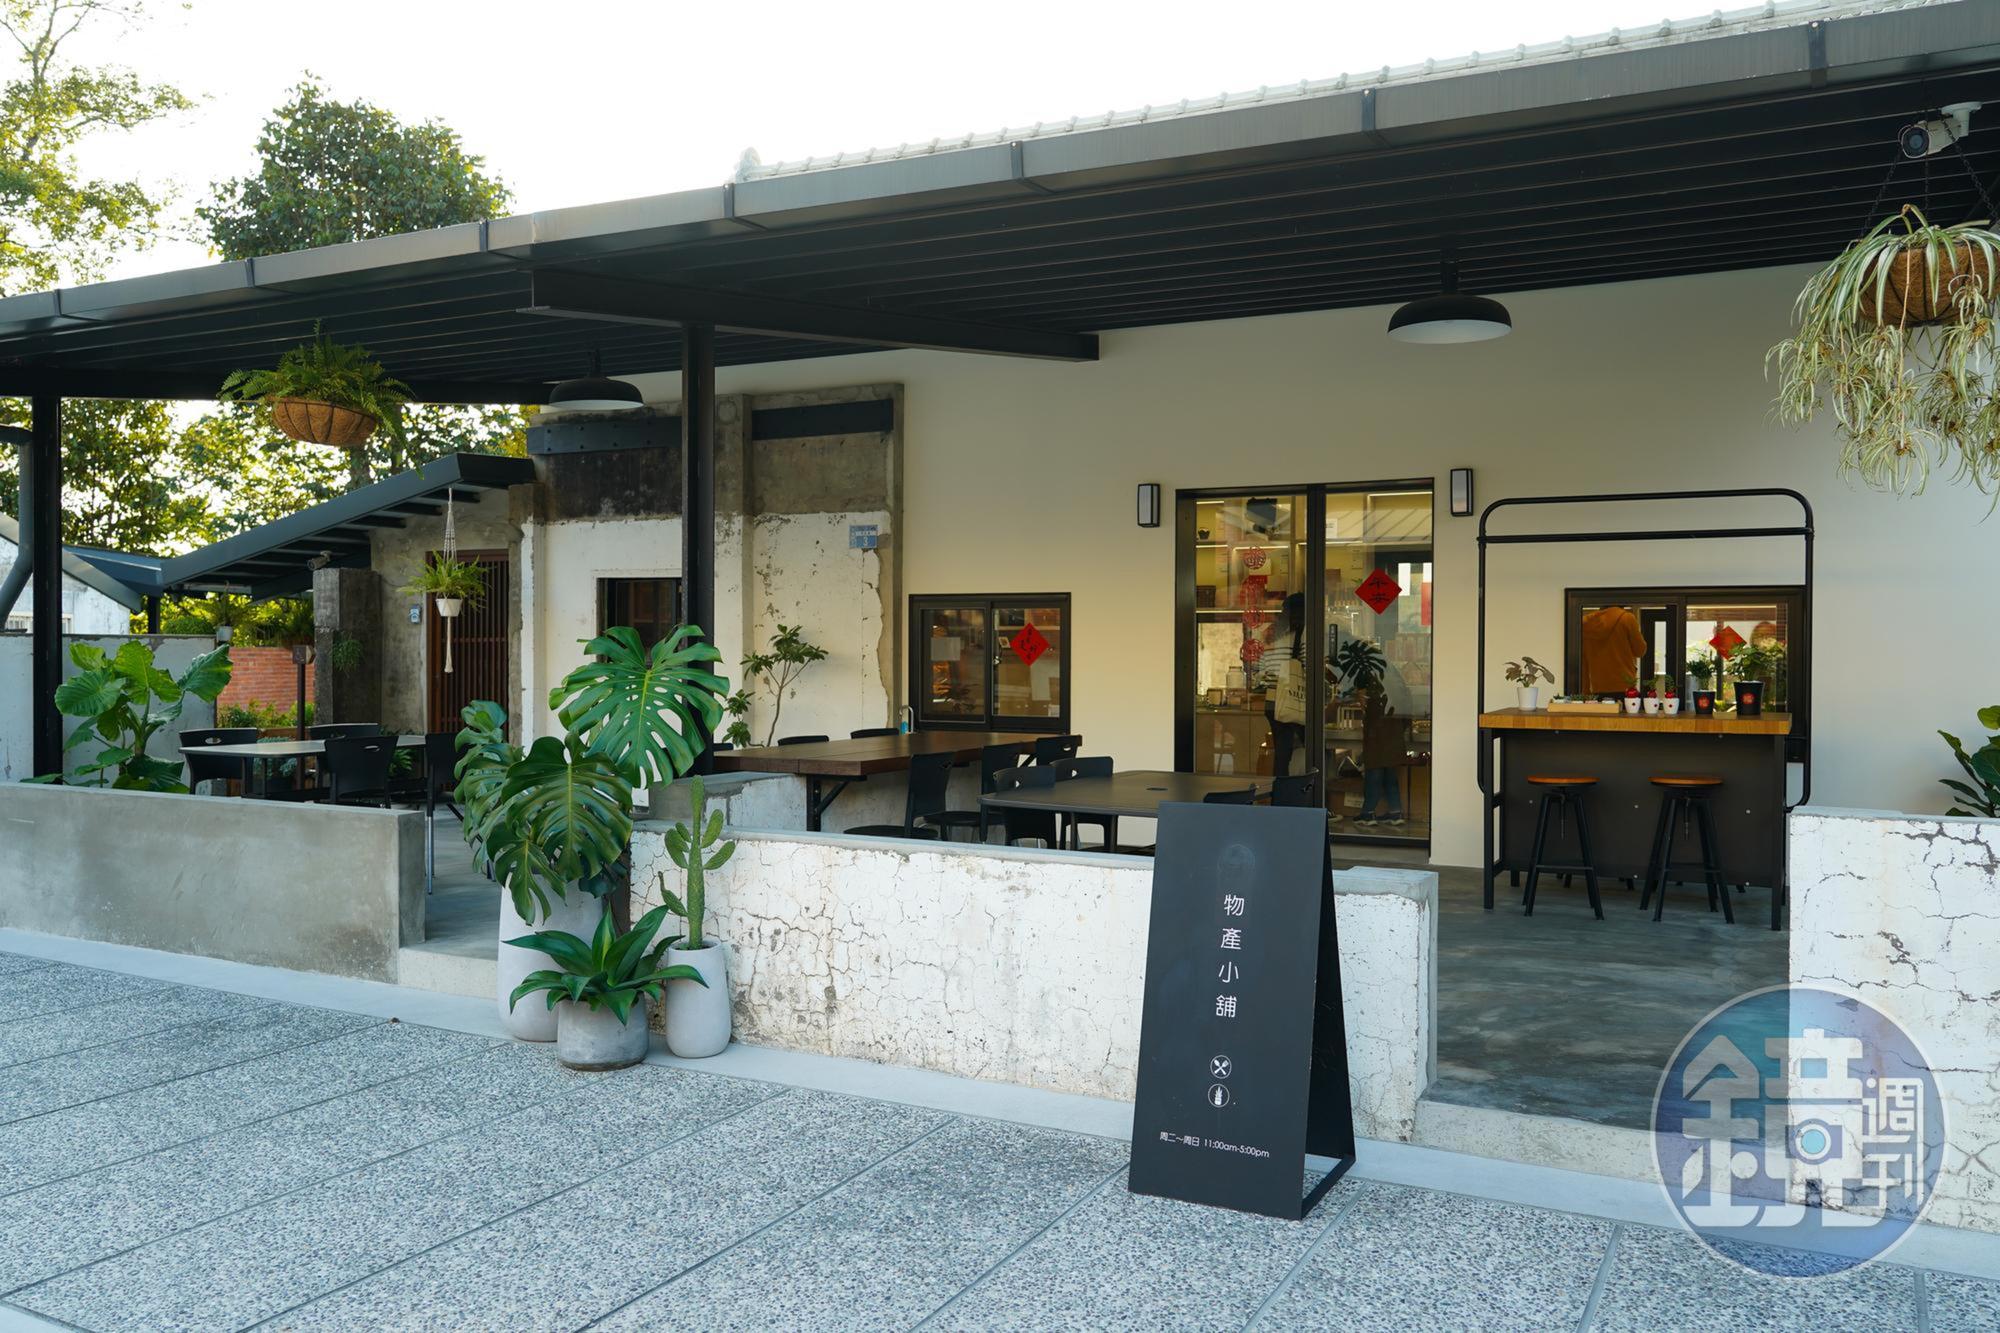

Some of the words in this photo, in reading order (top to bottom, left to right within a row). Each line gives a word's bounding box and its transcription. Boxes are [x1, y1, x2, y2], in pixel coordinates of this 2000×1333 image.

[1215, 893, 1245, 1018] 物產小舖
[1203, 1138, 1270, 1158] 11:00am-5:00pm
